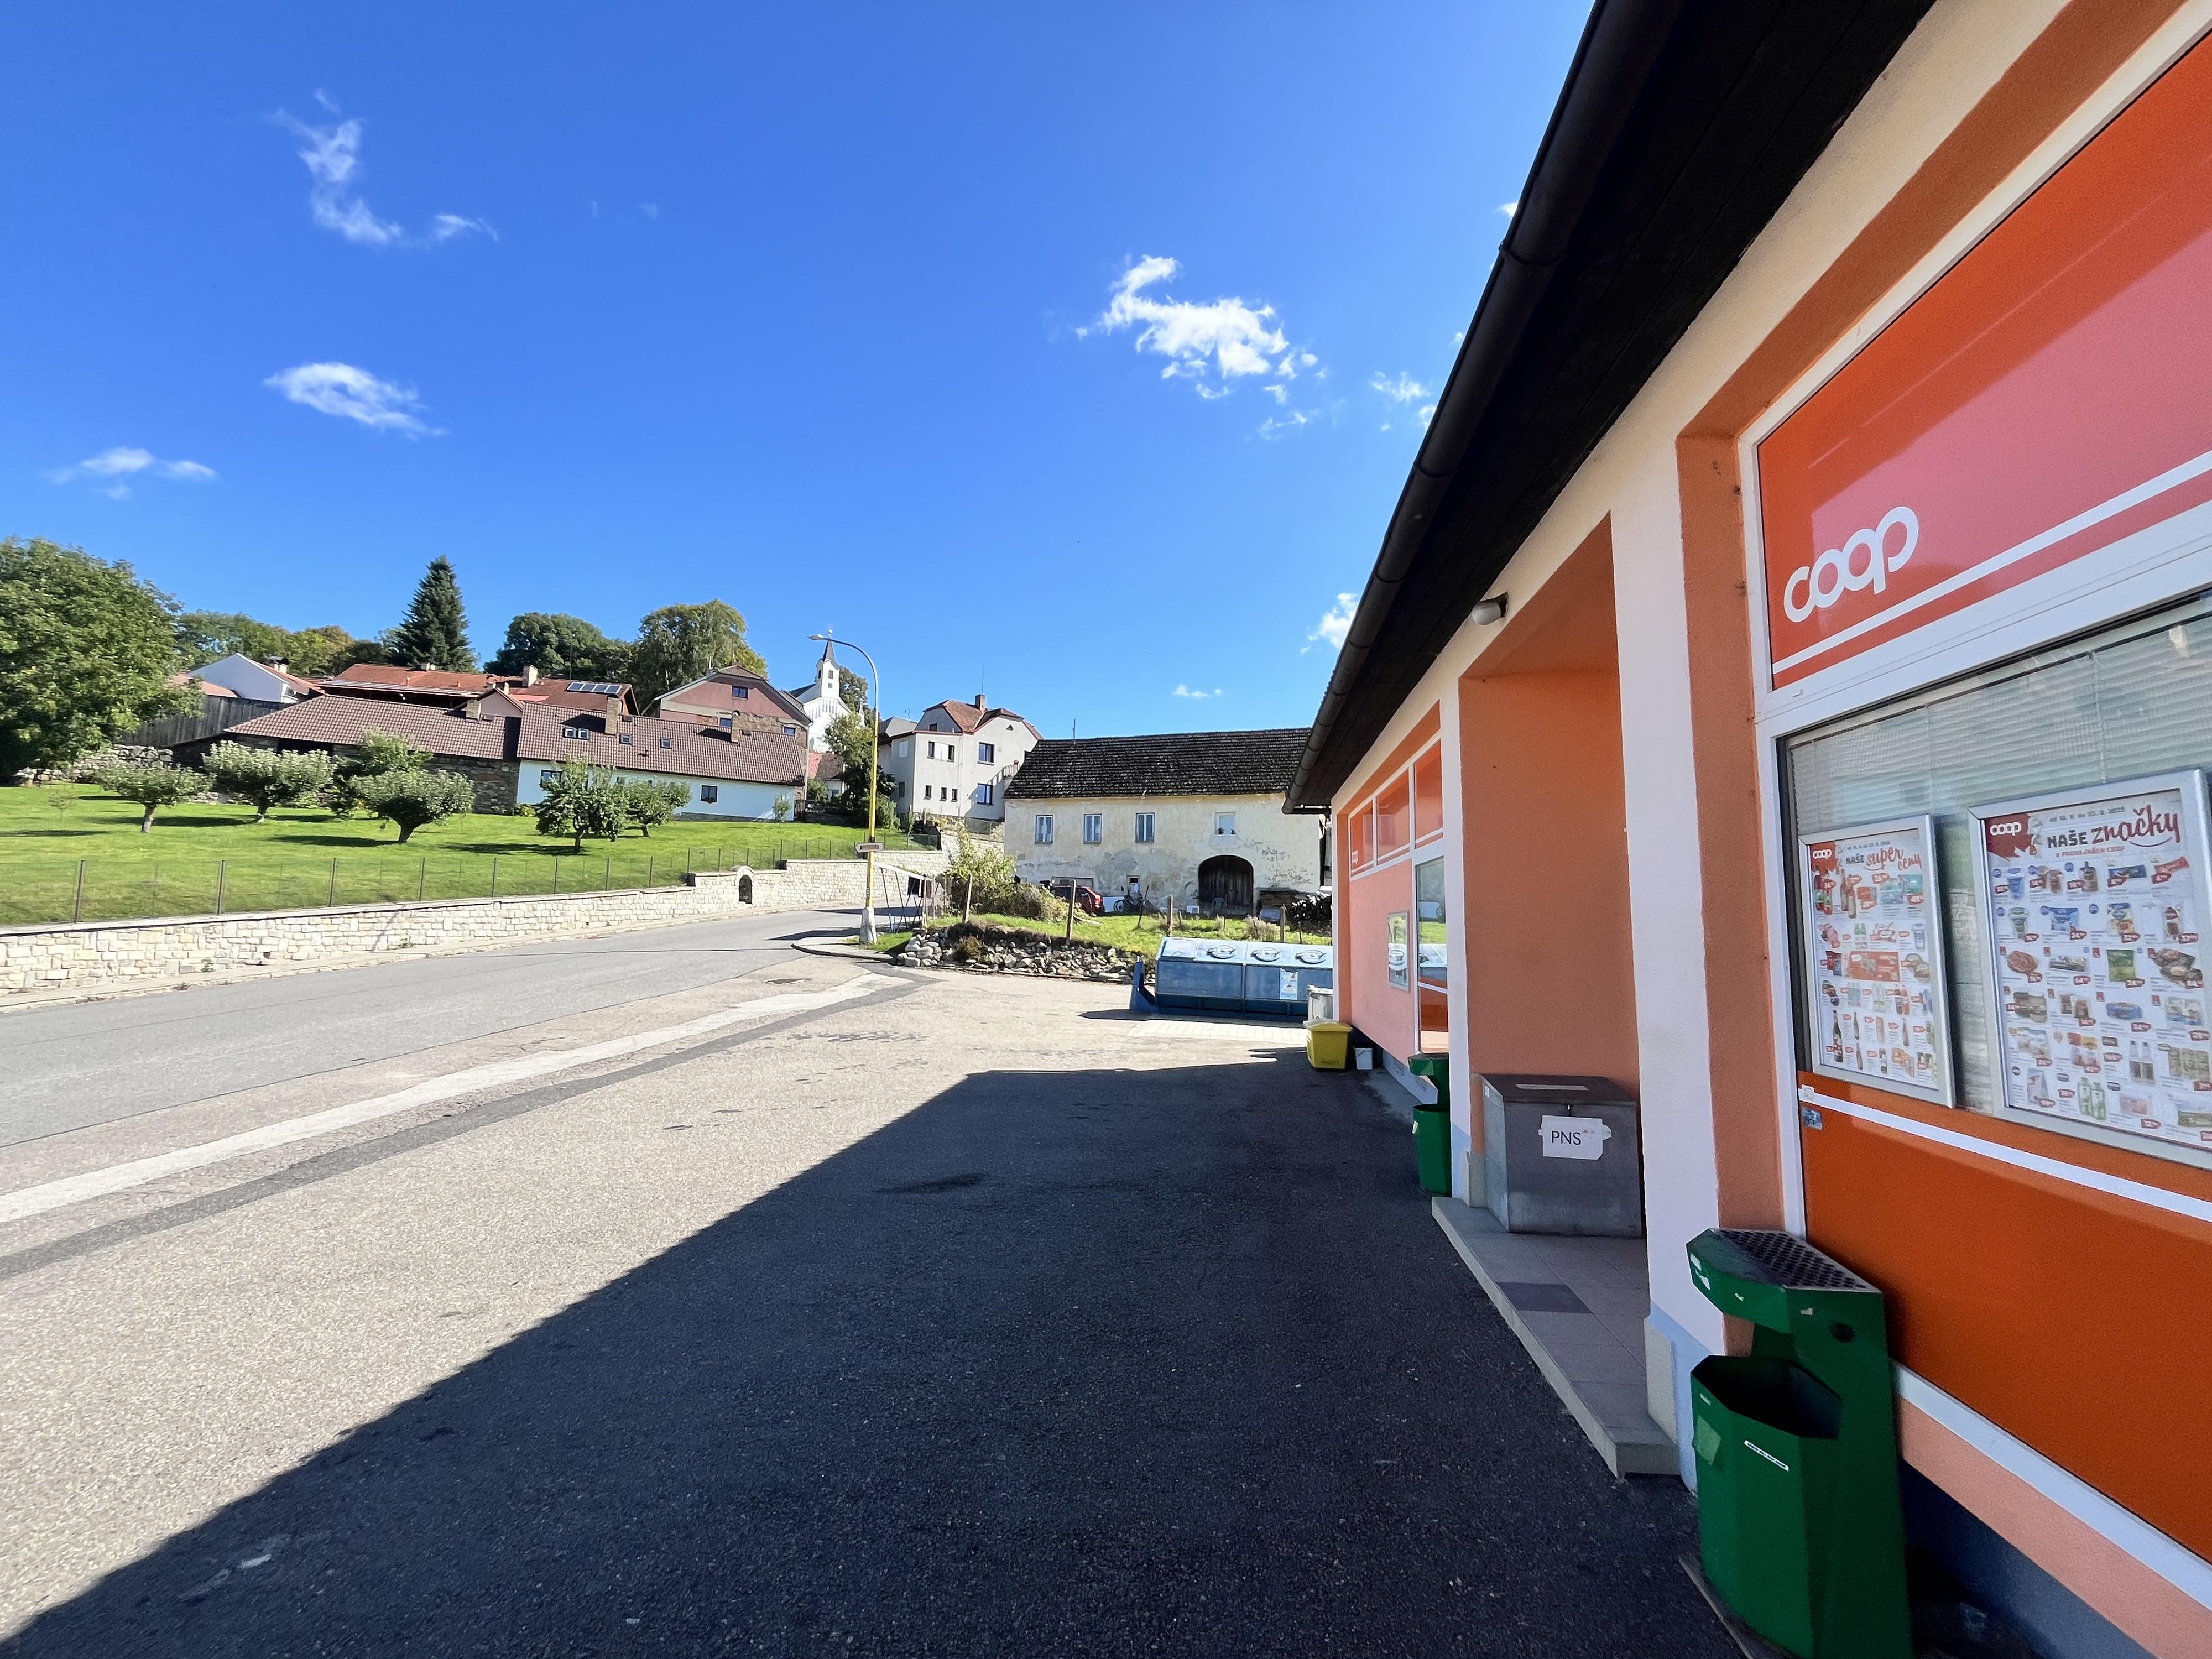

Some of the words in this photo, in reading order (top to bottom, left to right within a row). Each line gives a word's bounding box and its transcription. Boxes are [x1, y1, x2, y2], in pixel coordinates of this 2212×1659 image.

[1783, 506, 1919, 623] coop
[1990, 821, 2022, 836] coop
[2047, 829, 2089, 848] NAŠE
[2091, 804, 2180, 844] značky
[1845, 853, 1865, 864] NAŠE
[1866, 847, 1904, 870] super
[1897, 853, 1922, 872] ceny
[1551, 1130, 1582, 1145] PNS
